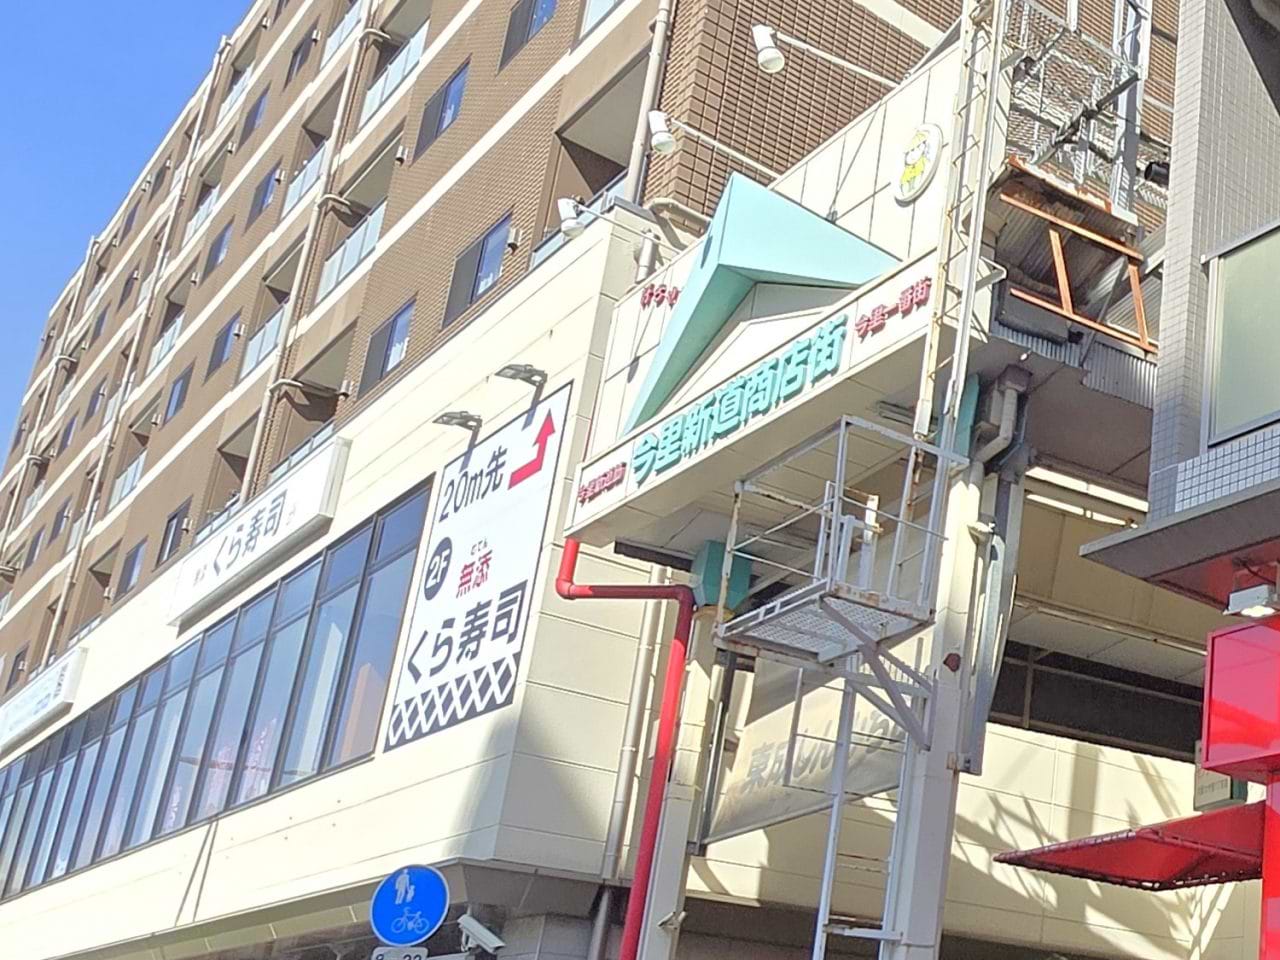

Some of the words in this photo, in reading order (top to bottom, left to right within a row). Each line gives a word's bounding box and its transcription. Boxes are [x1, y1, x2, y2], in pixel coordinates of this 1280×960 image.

[438, 446, 507, 523] 20m先
[213, 489, 288, 576] くら寿司
[425, 548, 451, 590] 2F
[456, 549, 493, 599] 無添
[407, 579, 528, 684] くら寿司
